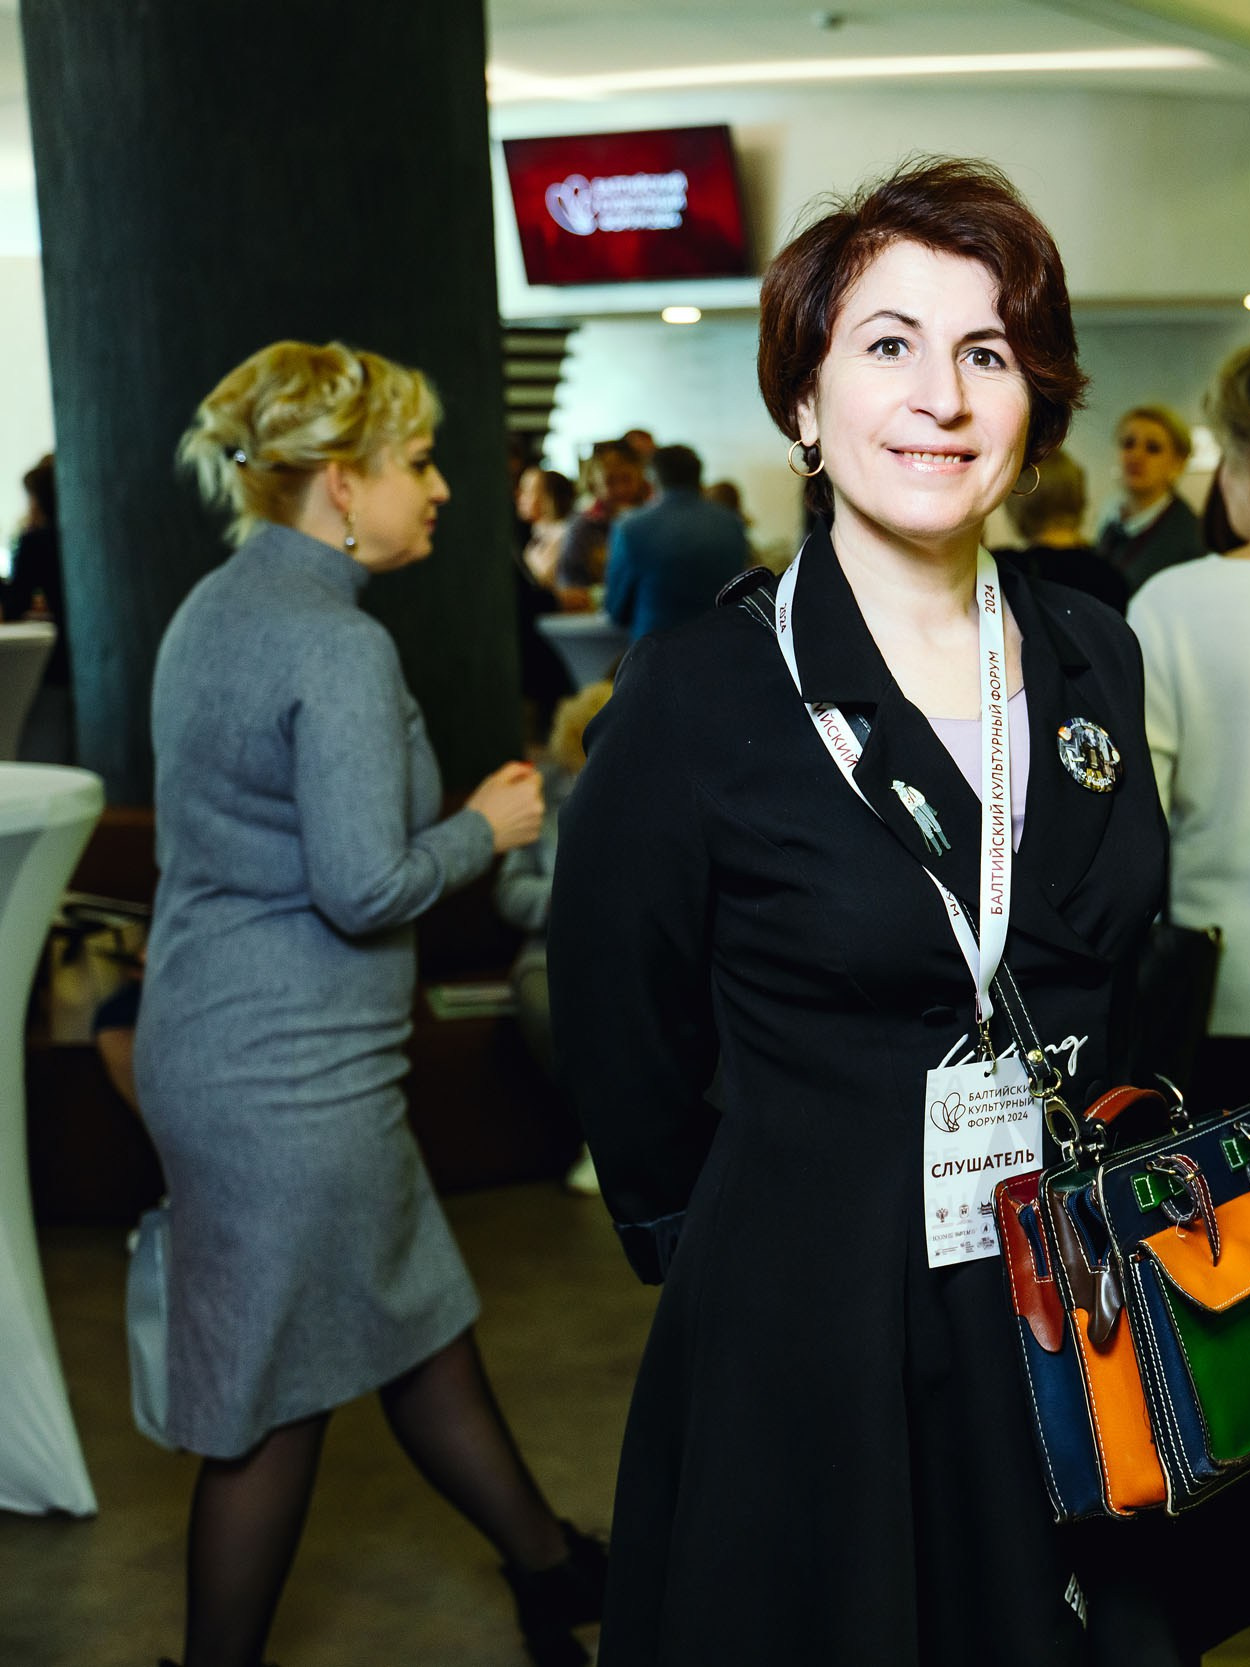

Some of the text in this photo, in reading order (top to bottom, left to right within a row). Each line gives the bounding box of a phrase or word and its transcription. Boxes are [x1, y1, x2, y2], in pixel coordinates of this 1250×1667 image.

[813, 703, 861, 768] ИЙСКИЙ
[985, 584, 1004, 915] БАЛТИЙСКИЙ КУЛЬТУРНЫЙ ФОРУМ 2024
[968, 1084, 1030, 1102] БАЛТИЙСКИ
[968, 1096, 1035, 1115] КУЛЬТУРНЫЙ
[967, 1111, 1029, 1129] ФОРУМ 2024
[930, 1148, 1036, 1179] СЛУШАТЕЛЬ
